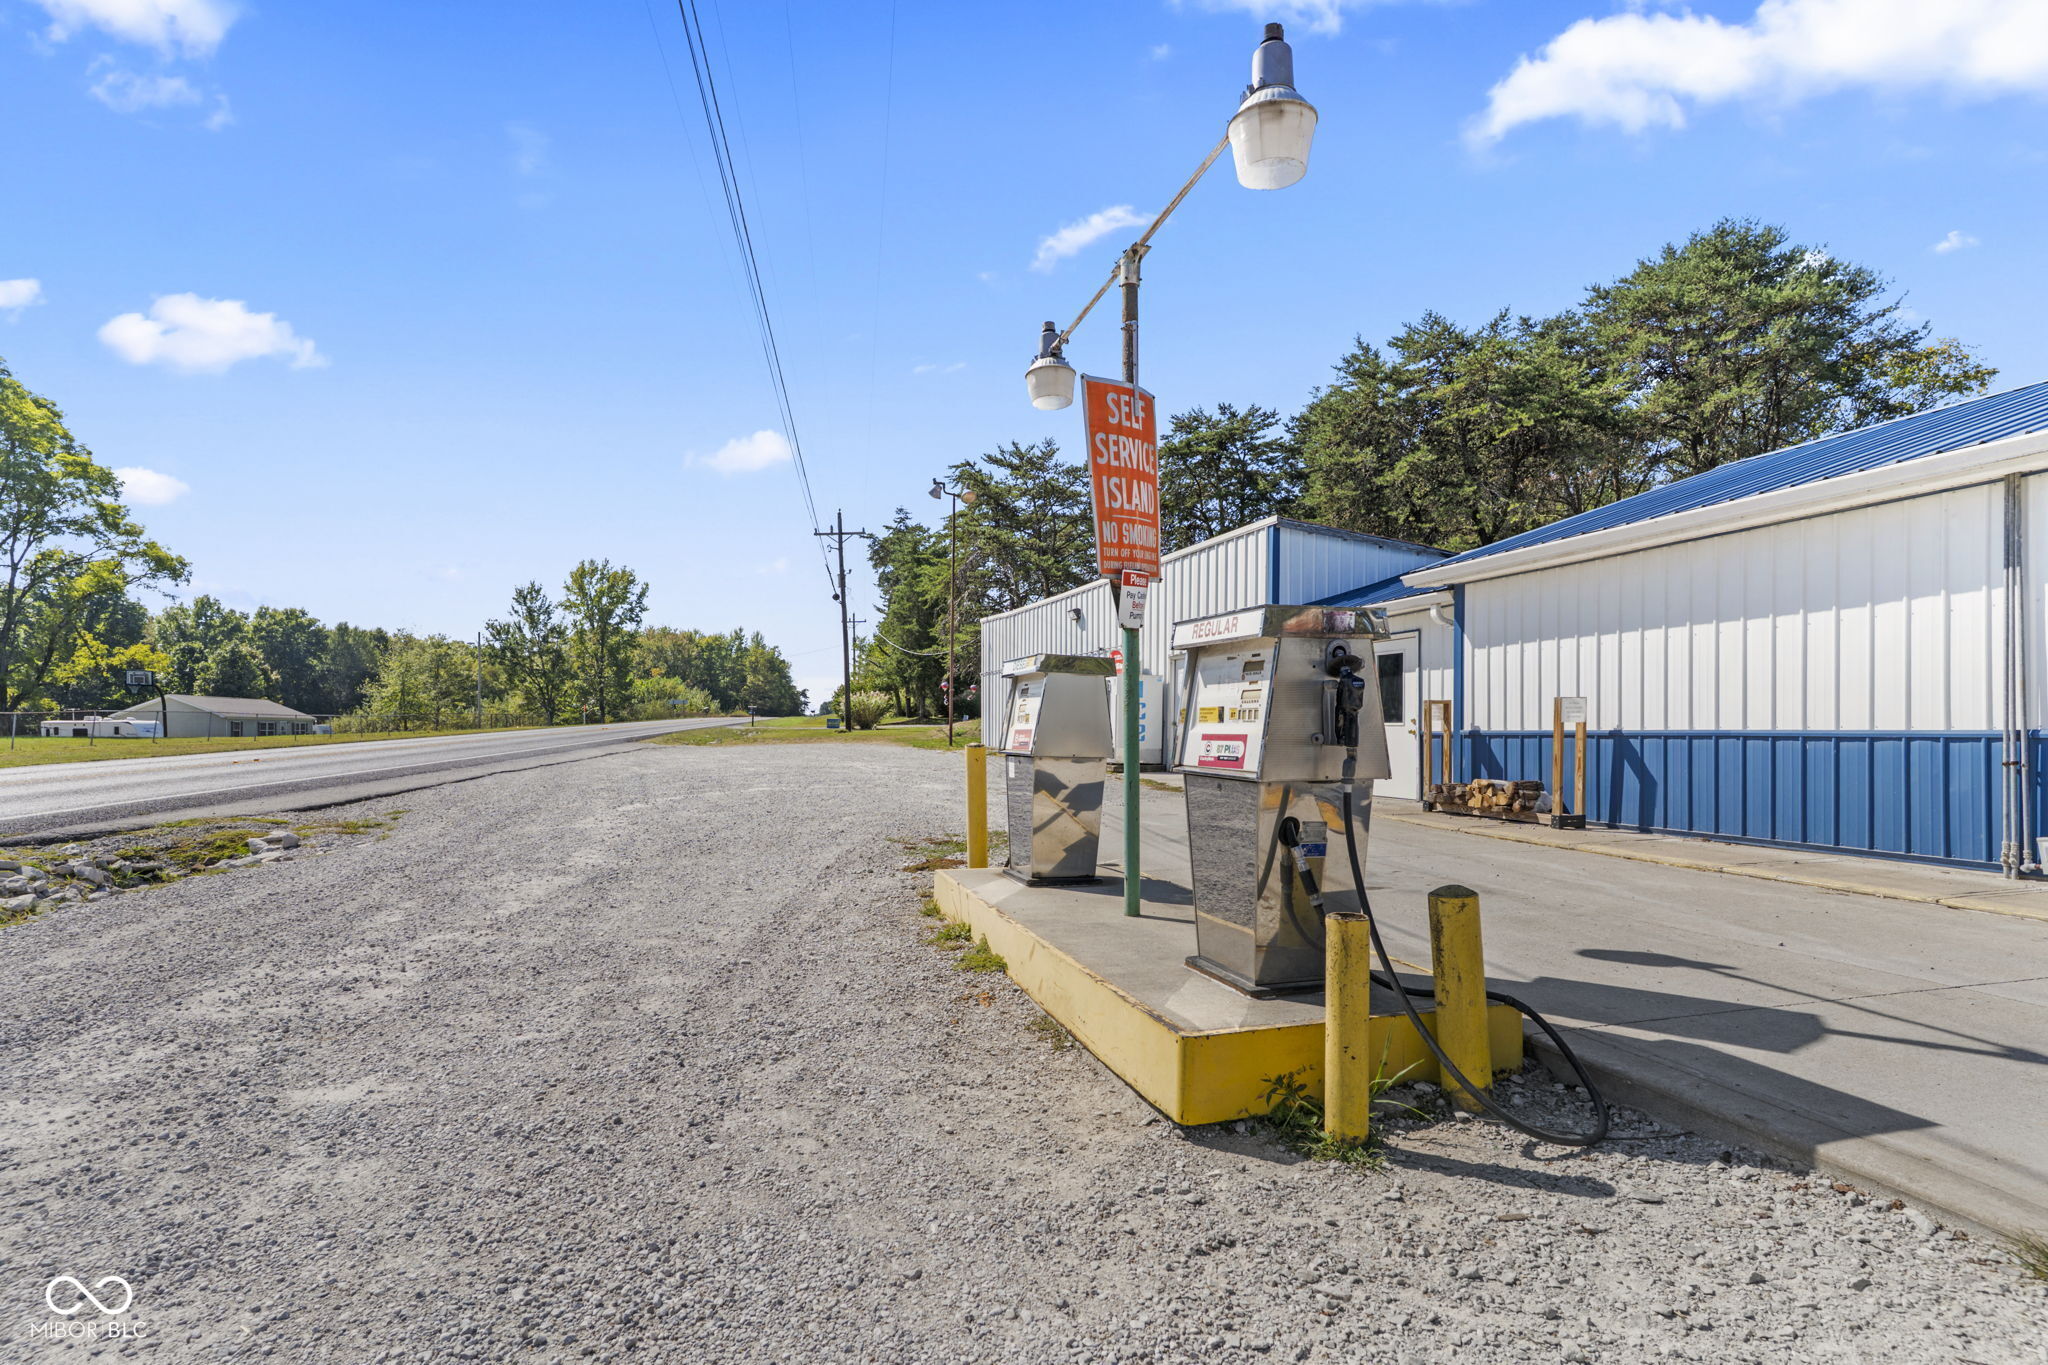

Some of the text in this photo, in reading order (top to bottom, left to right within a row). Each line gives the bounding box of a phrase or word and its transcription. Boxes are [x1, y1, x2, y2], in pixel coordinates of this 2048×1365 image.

[1106, 392, 1145, 430] SELF
[1095, 432, 1155, 475] SERVICE
[1102, 475, 1155, 515] ISLAND
[1102, 520, 1157, 548] NO SMOKING
[1103, 547, 1119, 557] TURN
[1121, 548, 1131, 558] OFF
[1103, 560, 1122, 569] DURING
[1126, 590, 1136, 600] Pay
[1192, 616, 1239, 639] REGULAR
